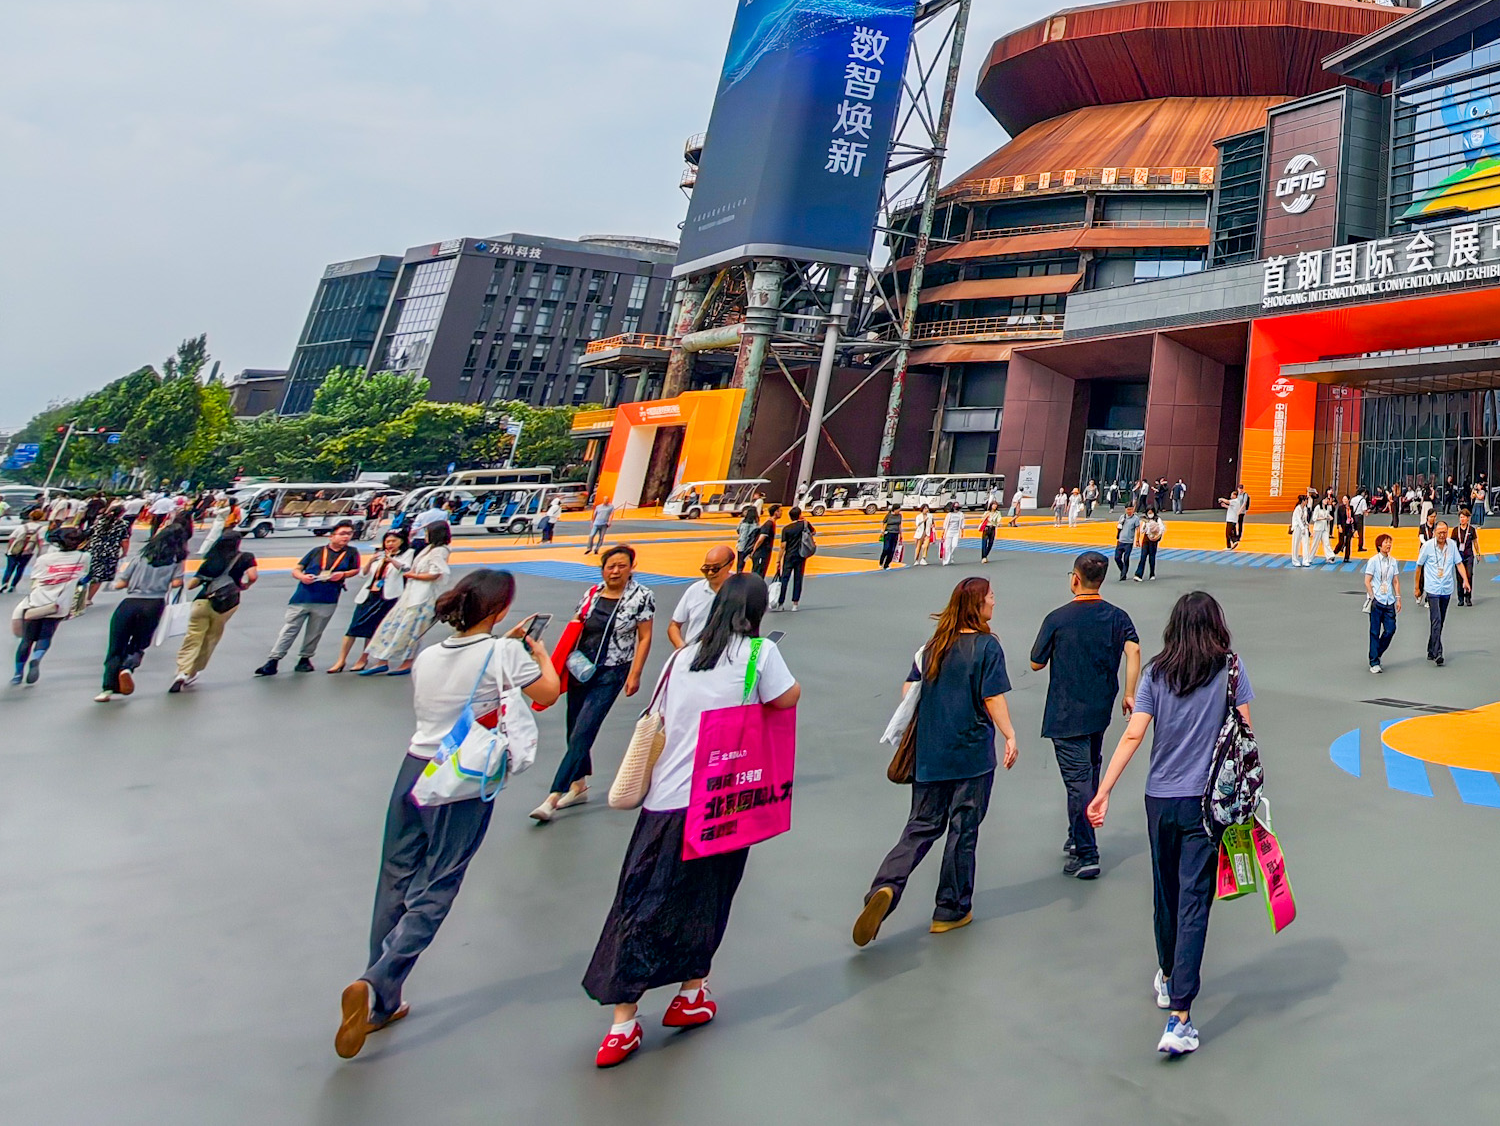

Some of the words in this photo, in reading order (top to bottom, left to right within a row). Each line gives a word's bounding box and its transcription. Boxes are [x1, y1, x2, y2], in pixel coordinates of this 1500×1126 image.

[824, 25, 889, 177] 数智焕新
[1275, 169, 1326, 197] CIFTIS
[1262, 292, 1308, 309] SHOUGANG
[1308, 283, 1376, 303] INTERNATIONAL
[1379, 273, 1437, 293] CONVENTION
[1437, 269, 1465, 284] AND
[1271, 384, 1295, 392] CIFTIS
